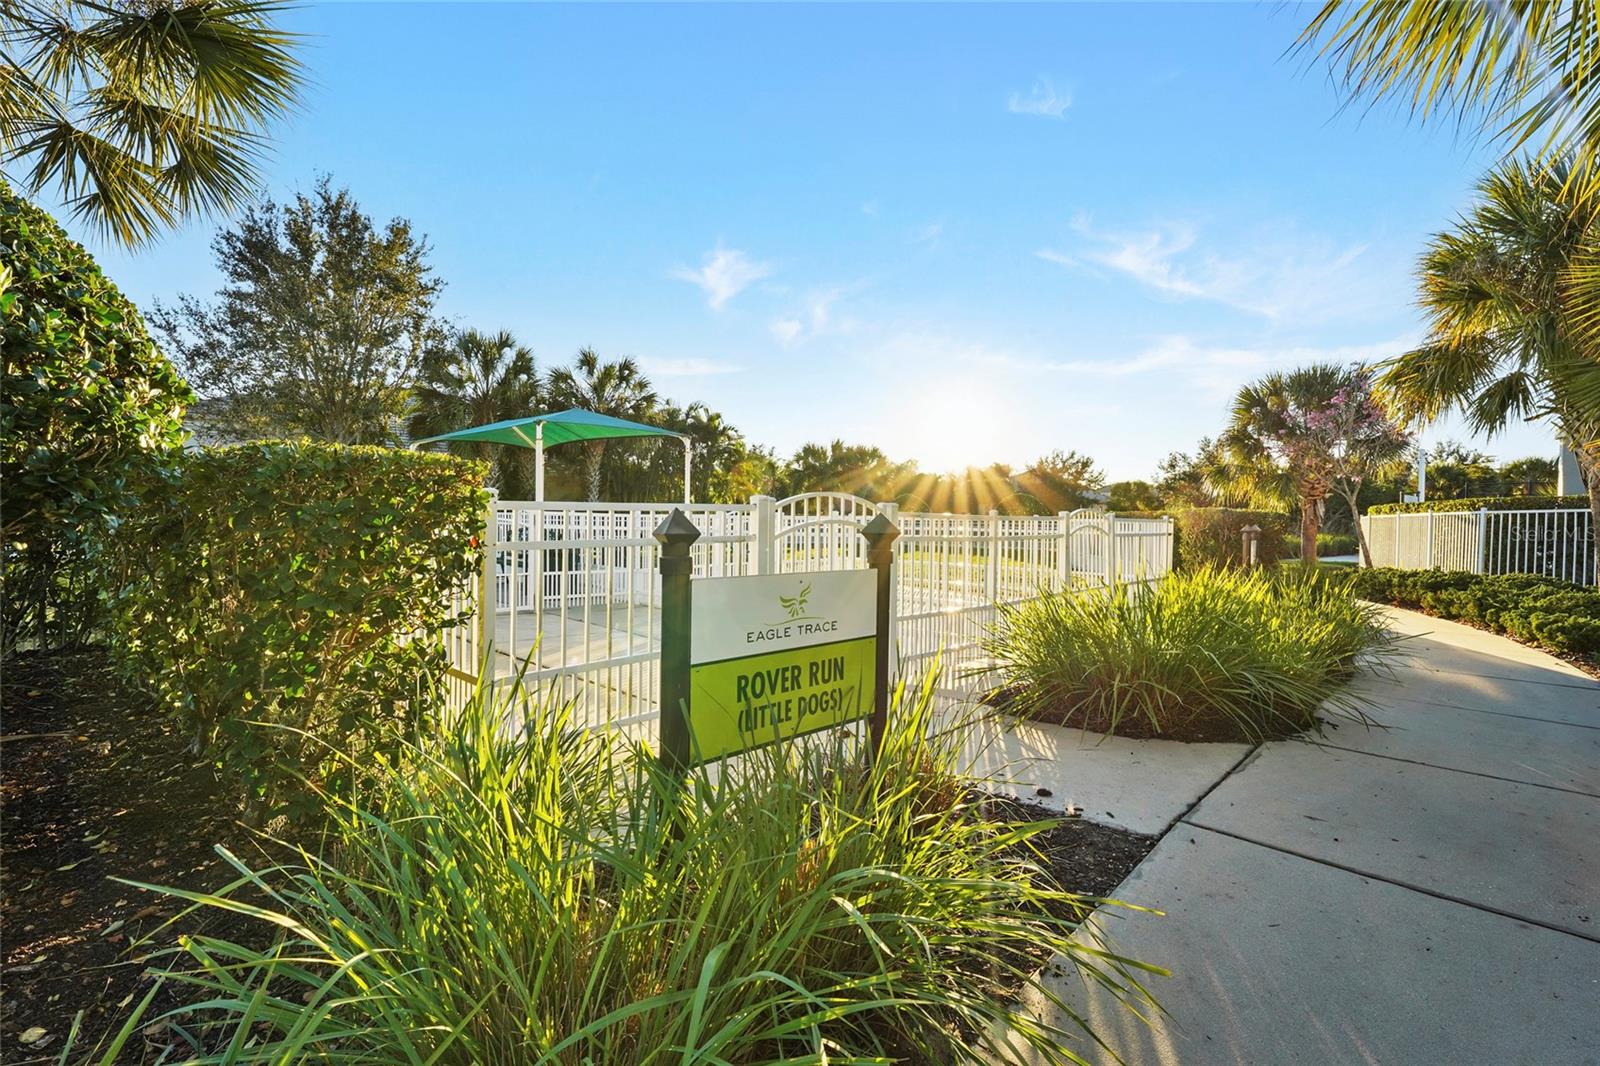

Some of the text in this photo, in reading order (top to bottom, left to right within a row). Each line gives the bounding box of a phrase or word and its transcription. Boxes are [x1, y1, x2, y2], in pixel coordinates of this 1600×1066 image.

[746, 620, 838, 643] EAGLE TRACE
[736, 656, 844, 703] ROVER RUN
[737, 687, 843, 733] (LITTLE DOGS)
